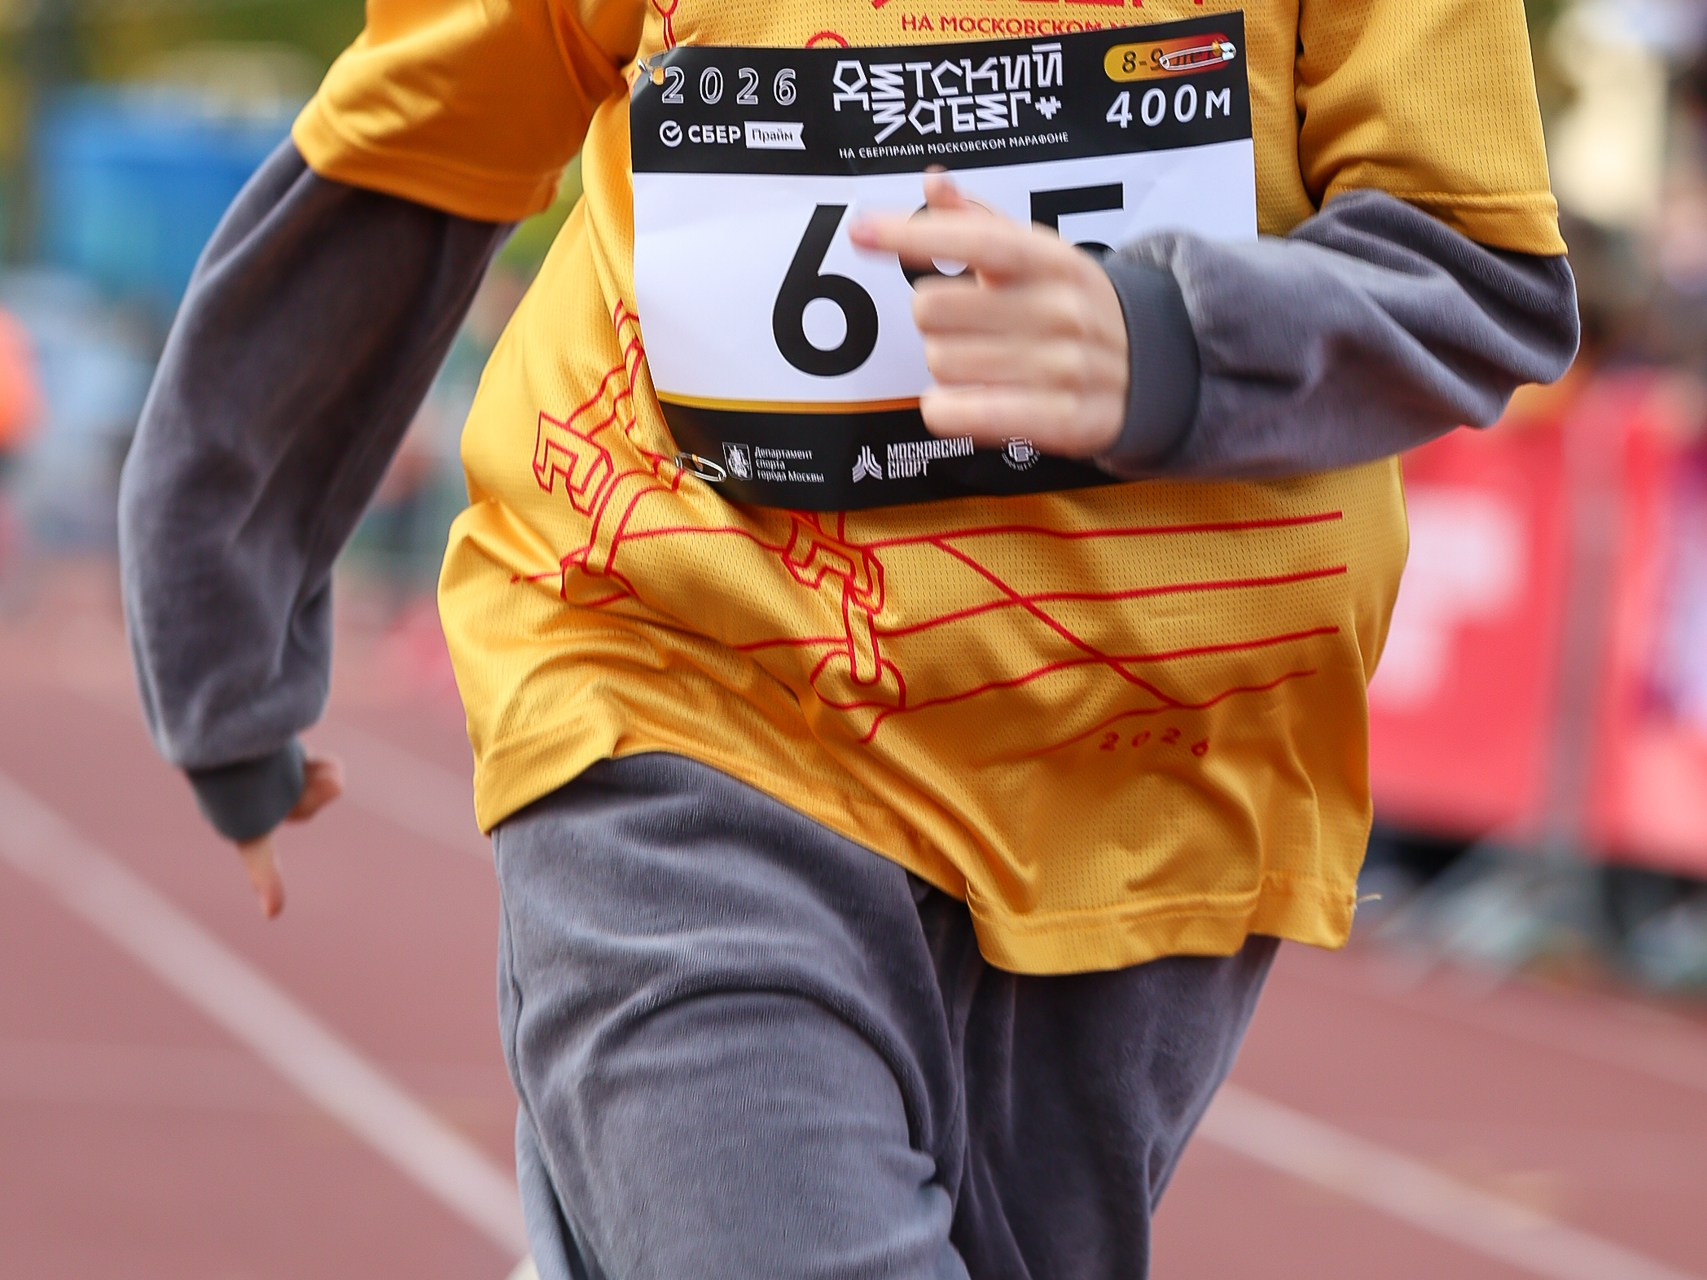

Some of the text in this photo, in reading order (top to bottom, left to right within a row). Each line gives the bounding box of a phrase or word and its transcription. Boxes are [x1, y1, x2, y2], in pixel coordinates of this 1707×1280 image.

[902, 15, 934, 31] НА
[661, 66, 797, 106] 2026
[832, 43, 1063, 111] ДЕТСКИЙ
[871, 91, 1032, 144] ЗАБЕГ
[687, 124, 794, 144] СБЕР Прайм
[839, 131, 1069, 159] НА СБЕРПРАЙМ МОСКОВСКОМ МАРАФОНЕ
[755, 446, 813, 460] Департамент
[887, 433, 975, 461] МОСКОВСКИЙ
[757, 470, 824, 483] города Москвы
[887, 459, 929, 480] СПОРТ
[1099, 727, 1210, 757] 2026
